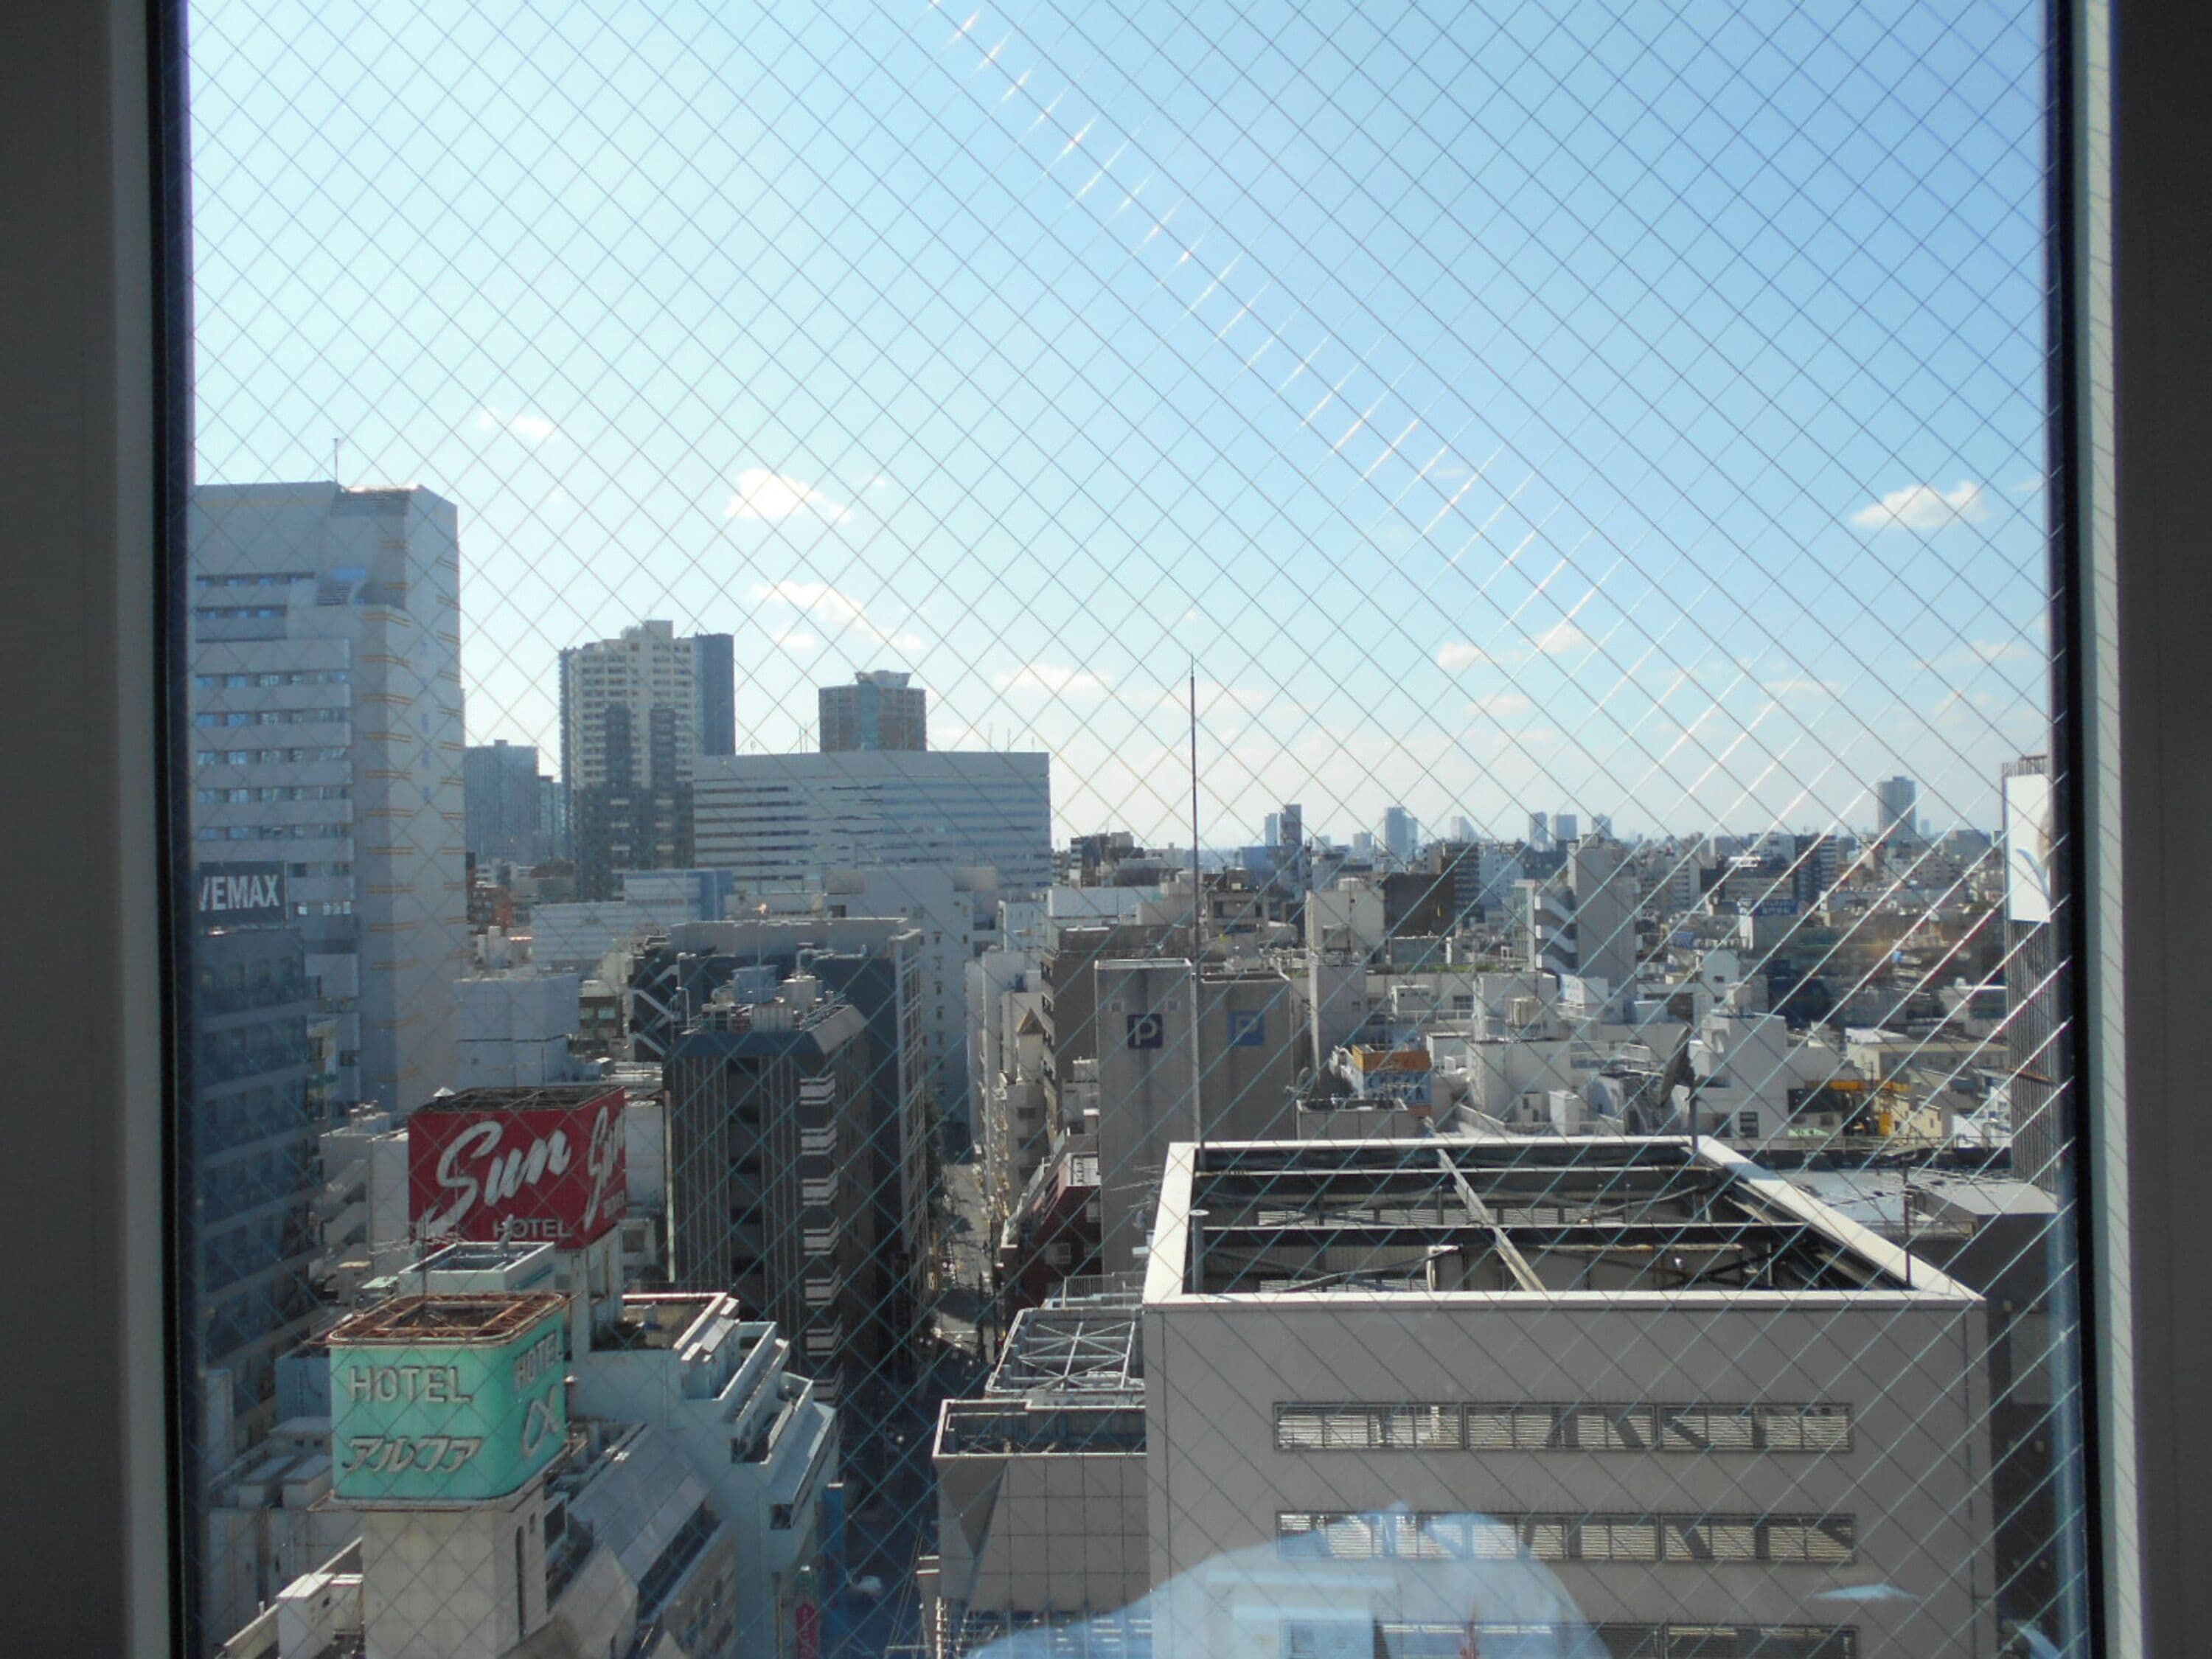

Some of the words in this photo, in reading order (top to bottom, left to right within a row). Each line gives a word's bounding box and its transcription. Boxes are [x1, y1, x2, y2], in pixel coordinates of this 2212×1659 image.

[1134, 1016, 1158, 1046] P
[416, 1120, 572, 1238] Sun
[494, 1220, 571, 1239] HOTEL
[515, 1332, 564, 1391] HOTEL
[349, 1366, 473, 1402] HOTEL
[341, 1436, 484, 1472] アルファ
